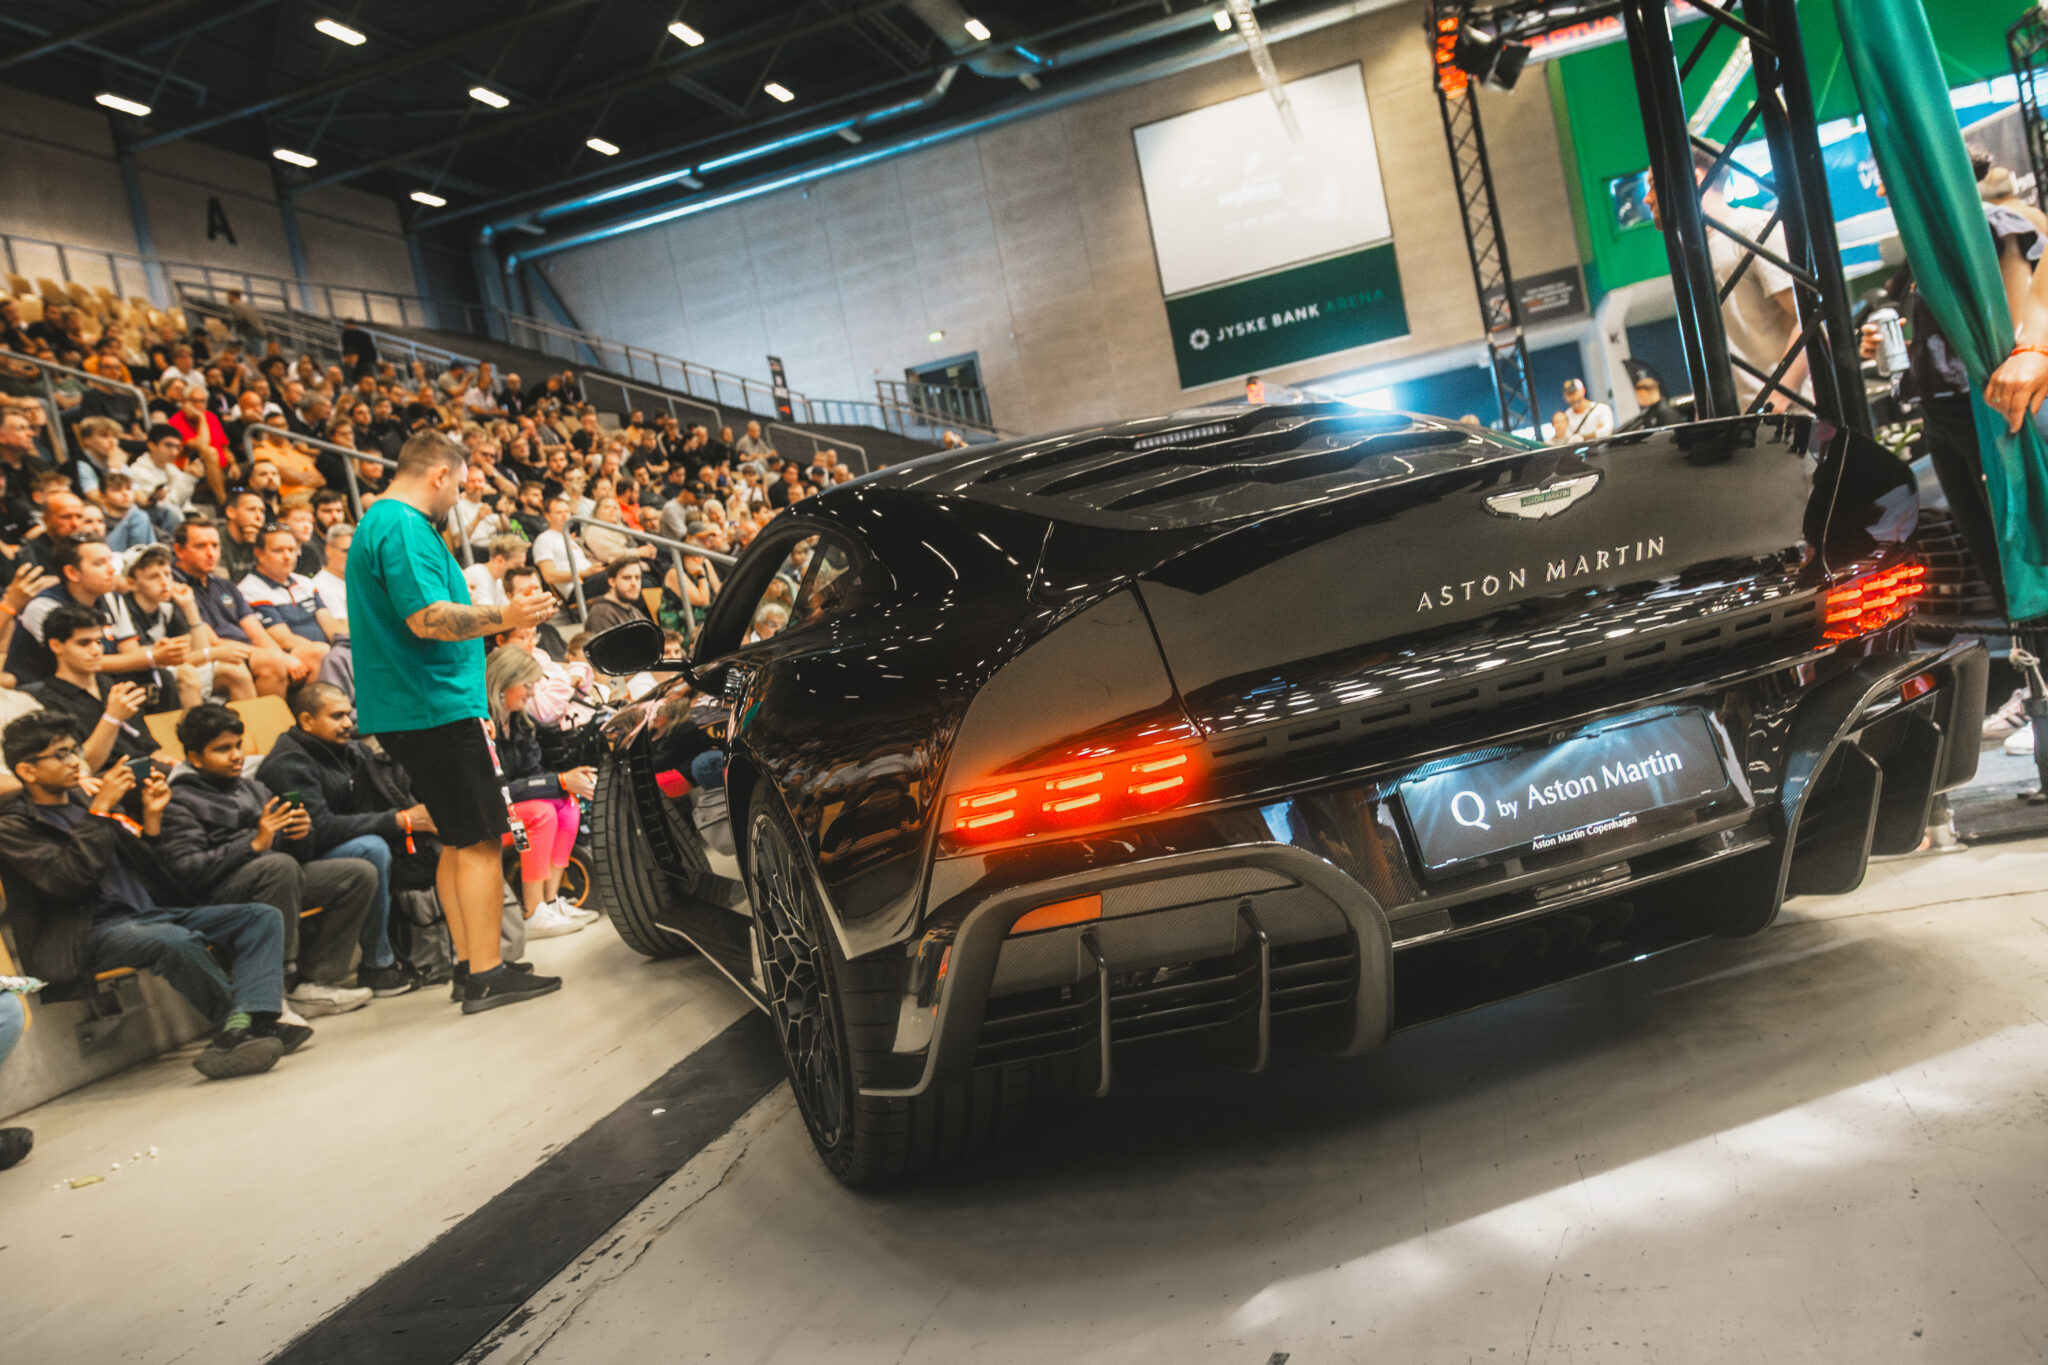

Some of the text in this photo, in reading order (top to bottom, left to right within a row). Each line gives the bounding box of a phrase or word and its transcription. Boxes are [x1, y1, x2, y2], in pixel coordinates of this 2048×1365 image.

[208, 197, 237, 245] A
[1216, 288, 1385, 342] JYSKE BANK ARENA
[1545, 488, 1570, 501] MARTIN
[1416, 536, 1664, 612] ASTON MARTIN
[1451, 750, 1683, 830] Q by Aston Martin
[1532, 815, 1638, 851] Aston Martin Copenhagen
